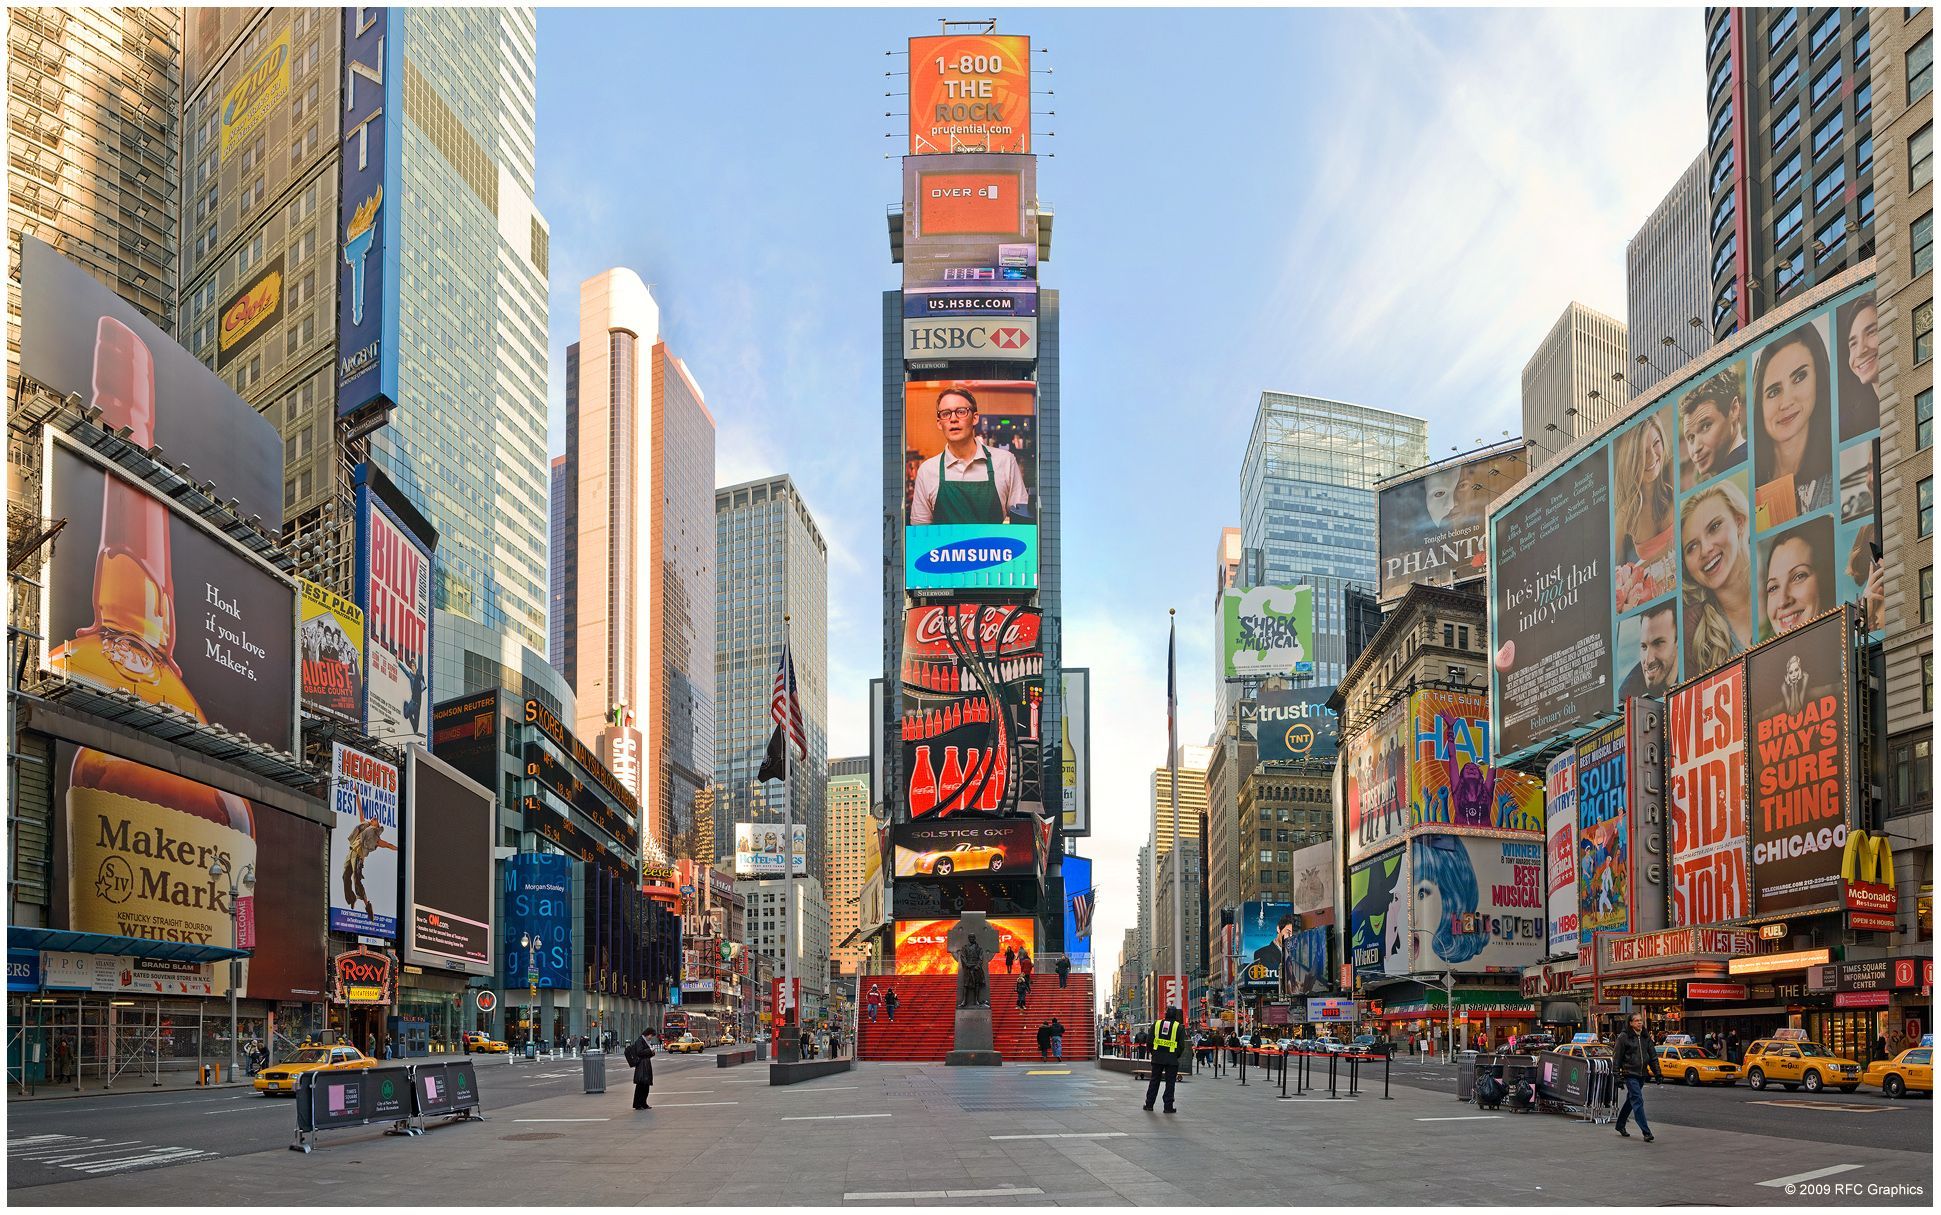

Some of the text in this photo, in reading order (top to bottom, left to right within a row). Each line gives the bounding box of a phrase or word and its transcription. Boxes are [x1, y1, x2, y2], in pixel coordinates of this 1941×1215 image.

[934, 54, 1003, 75] 1-800
[229, 45, 284, 127] Z100
[943, 79, 993, 100] THE
[935, 102, 1005, 123] ROCK
[931, 123, 1012, 136] prudential.com
[931, 186, 988, 198] OVER 6
[928, 299, 1012, 309] US.HSBC.COM
[909, 326, 987, 350] HSBC
[340, 338, 381, 376] ARGENT
[911, 361, 946, 370] SHERWOOD
[1573, 471, 1594, 490] Jennifer
[1545, 496, 1569, 516] Barrymore
[1564, 504, 1590, 525] Johansson
[1424, 533, 1447, 545] Tonight
[1447, 527, 1472, 540] belongs
[372, 511, 420, 611] BILLY
[929, 548, 1013, 563] SAMSUNG
[419, 560, 427, 618] THE MUSICAL
[917, 589, 950, 597] SHERWOOD
[1505, 562, 1563, 612] he's just
[1539, 557, 1600, 608] not that
[206, 582, 242, 620] Honk
[332, 598, 362, 620] PLAY
[1518, 585, 1579, 634] into you
[370, 579, 426, 664] ELLIOT
[915, 604, 1023, 645] Coca-Cola
[1237, 614, 1298, 639] SHREK
[205, 612, 266, 659] if you love
[1242, 634, 1299, 652] MUSICAL
[205, 638, 258, 682] Maker's.
[302, 659, 353, 689] AUGUST:
[303, 686, 353, 697] OSAGE COUNTY
[1433, 692, 1480, 706] THE SUN
[463, 696, 495, 712] REUTERS
[1670, 661, 1744, 769] WEST
[525, 700, 537, 722] S
[538, 706, 565, 746] KOREA
[1530, 709, 1562, 730] February
[1563, 701, 1577, 715] 6th
[1757, 695, 1837, 744] BROAD
[1289, 733, 1310, 744] TNT
[1415, 714, 1491, 766] HAI
[1757, 718, 1838, 765] WAY'S
[1553, 757, 1567, 771] DO FOR
[1579, 743, 1612, 769] BEST MUSICAL
[341, 749, 397, 793] HEIGHTS
[1758, 745, 1838, 796] SURE
[357, 781, 372, 798] TONY
[375, 789, 396, 806] AWARD
[1361, 775, 1397, 815] JERSEY BOYS
[1643, 711, 1661, 884] PALACE
[1669, 751, 1747, 855] SIDE
[336, 788, 397, 829] BEST MUSICAL
[1758, 778, 1839, 833] THING
[96, 814, 233, 875] Maker's
[911, 828, 1014, 839] SOLSTICE GXP
[1501, 842, 1541, 859] WINNER!
[1753, 824, 1847, 866] CHICAGO
[740, 852, 803, 865] HOTEL DGS
[1501, 856, 1530, 866] 8 TONY AWARDS
[1513, 864, 1541, 887] BEST
[137, 866, 230, 914] Mark
[525, 883, 565, 893] Morgan Stanley
[1491, 884, 1542, 908] MUSICAL
[1671, 846, 1749, 928] STORY
[1762, 881, 1804, 894] TELECHARGE.COM
[1848, 888, 1897, 903] McDonald's
[1856, 899, 1889, 909] Restaurant
[117, 911, 213, 932] KENTUCKY STRAIGHT BOURBON
[236, 900, 247, 949] WELCOME
[1450, 911, 1545, 941] hairspray
[1557, 912, 1578, 934] HBO
[1598, 924, 1616, 933] CENTER
[1763, 925, 1783, 937] FUEL
[1852, 917, 1869, 925] OPEN
[1876, 919, 1895, 927] HOURS
[117, 921, 213, 945] WHISKY
[907, 935, 948, 945] SOLS
[1701, 928, 1732, 953] WEST
[1611, 929, 1692, 962] WEST SIDE STORY
[141, 961, 194, 971] GRAND SLAM
[1353, 947, 1379, 967] WICKED
[151, 973, 176, 981] SOUVENIR
[176, 974, 192, 982] STORE
[340, 958, 385, 982] ROXY
[1842, 963, 1887, 974] TIMES SQUARE
[1843, 971, 1886, 981] INFORMATION
[1778, 985, 1800, 998] THE
[1853, 980, 1877, 989] CENTER
[1468, 1003, 1498, 1011] sbarro
[1503, 1003, 1533, 1011] sbarro
